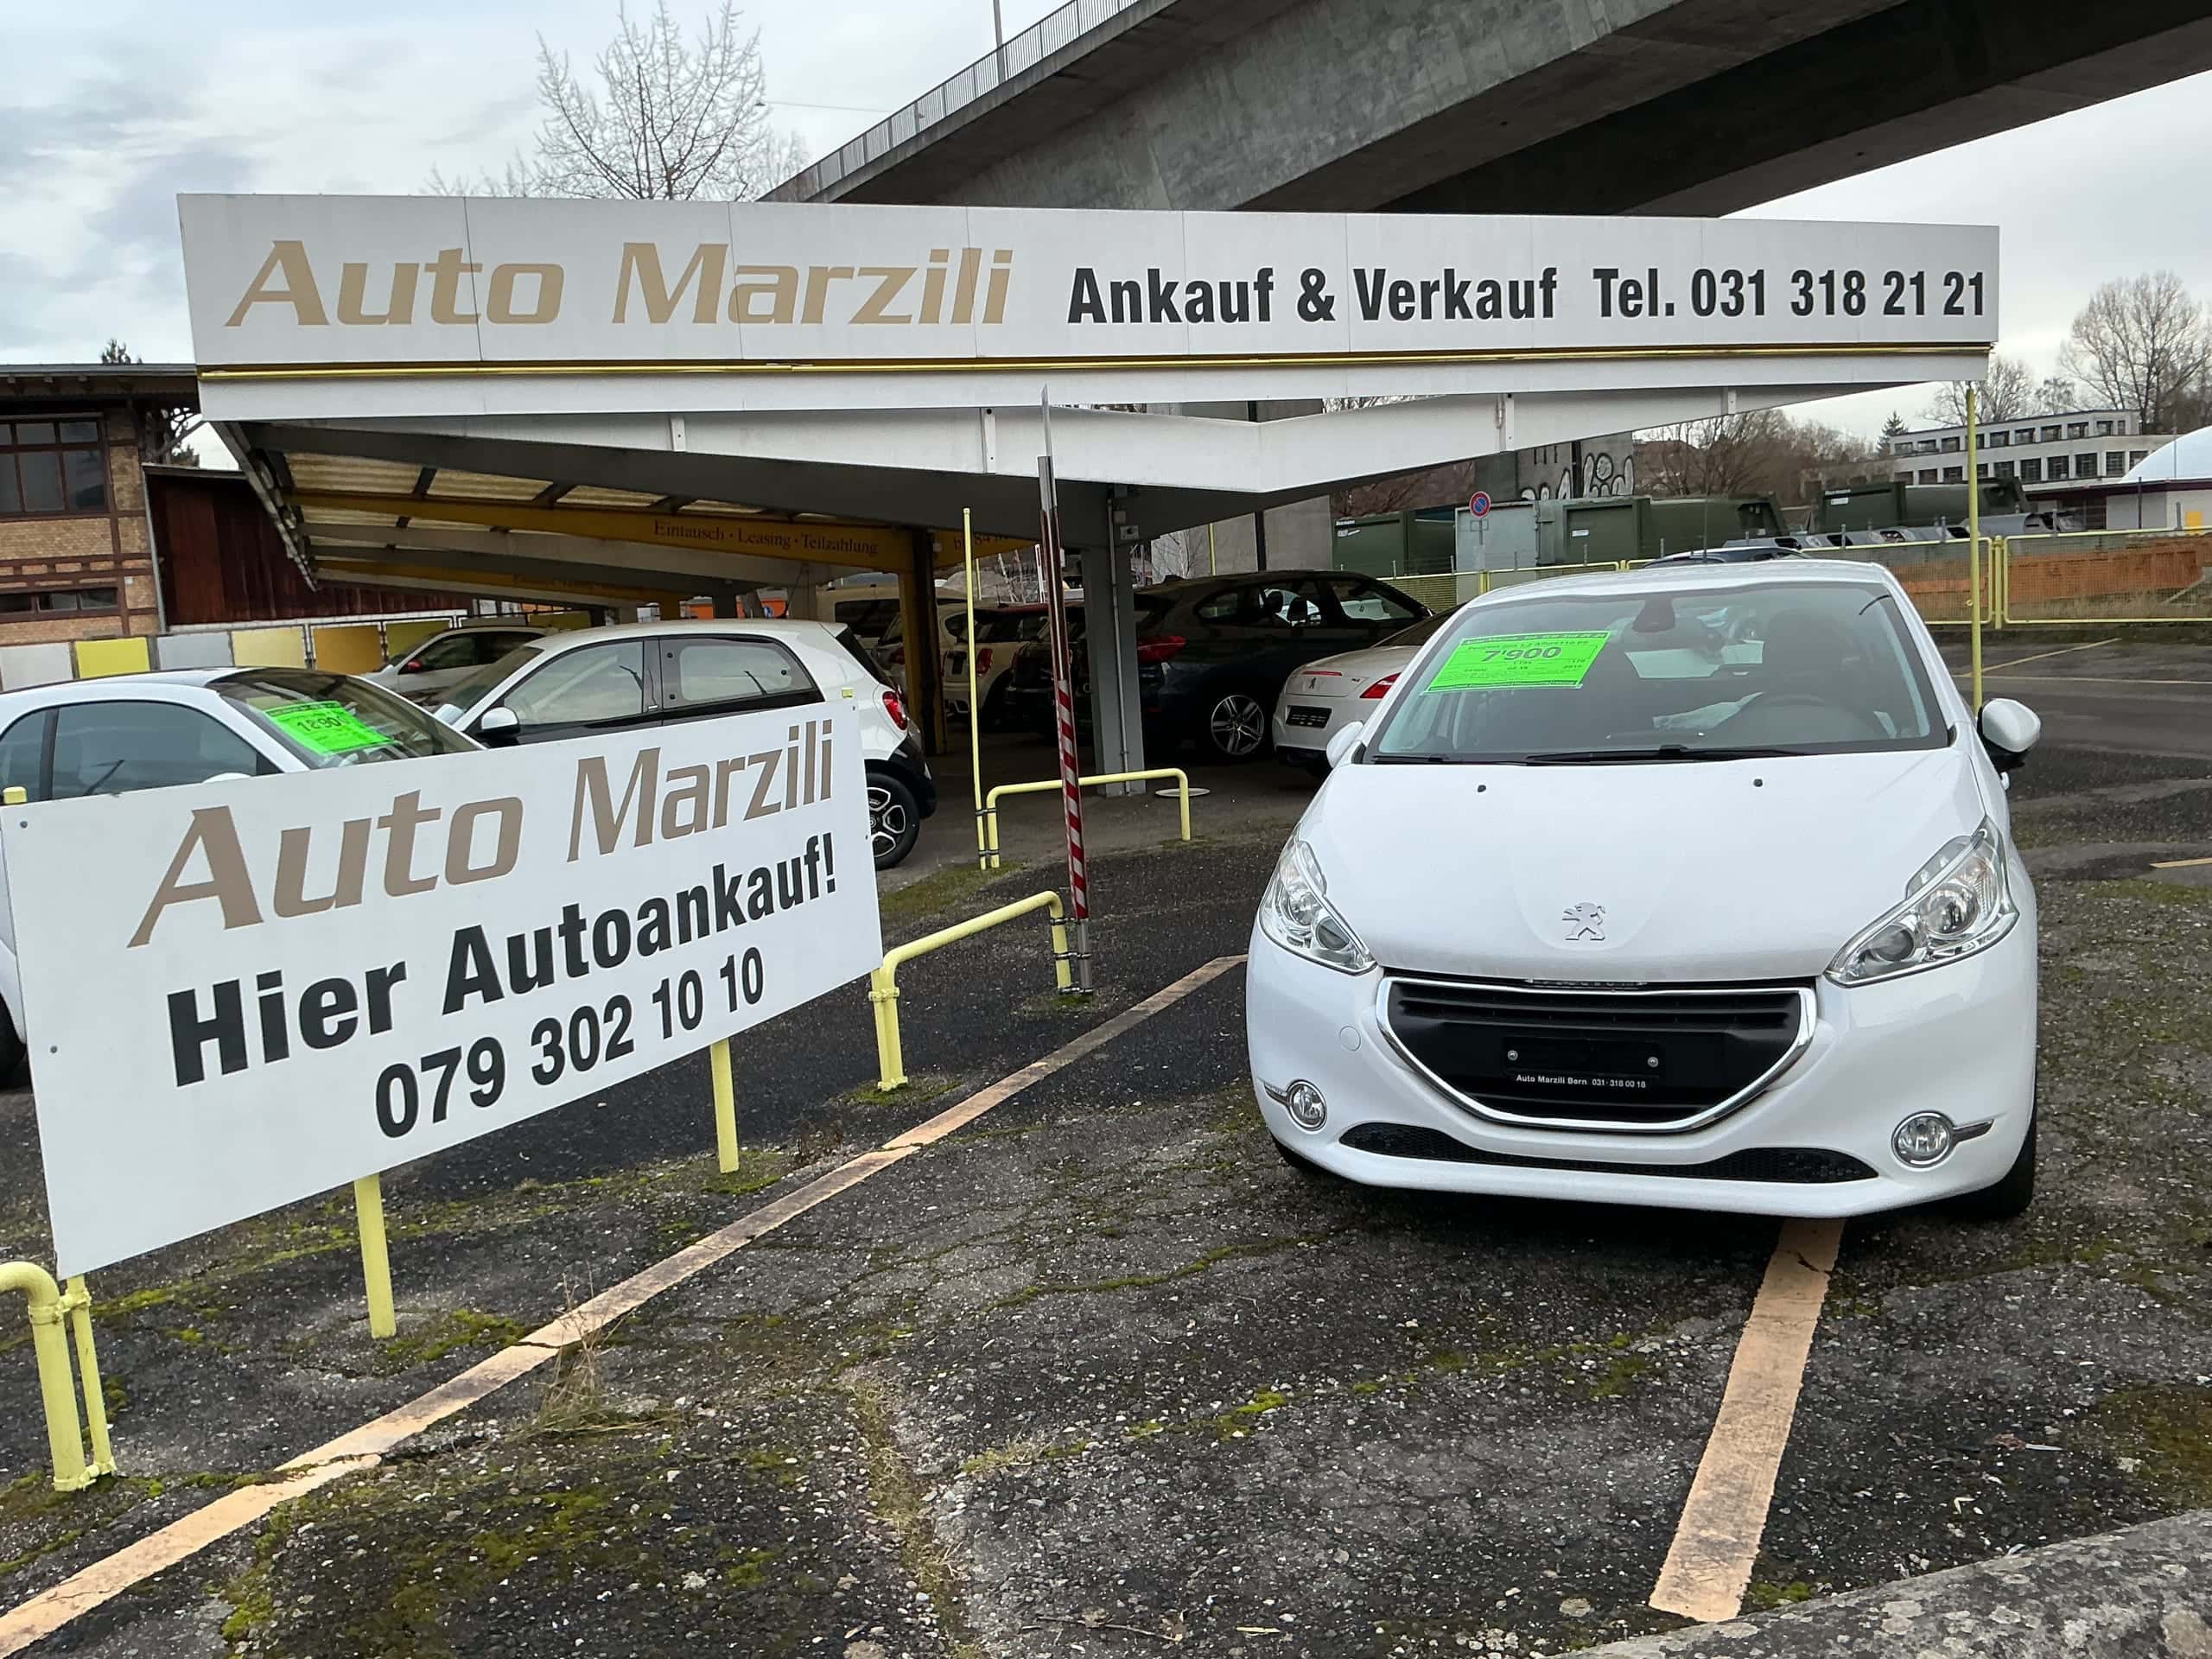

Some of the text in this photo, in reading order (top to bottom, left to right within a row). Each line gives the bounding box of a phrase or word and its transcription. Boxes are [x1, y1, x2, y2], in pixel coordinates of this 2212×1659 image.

[223, 239, 1984, 327] Auto Marzili Ankauf & Verkauf Tel. 031 318 21 21
[654, 520, 878, 556] Eintausch Leasing Teilzahlung
[1481, 646, 1562, 663] 7'900
[127, 719, 833, 948] Auto Marzili
[167, 832, 837, 1087] Hier Autoankauf!
[376, 947, 763, 1138] 079 302 10 10
[1516, 1074, 1535, 1083] Auto
[1538, 1076, 1566, 1084] Marzili
